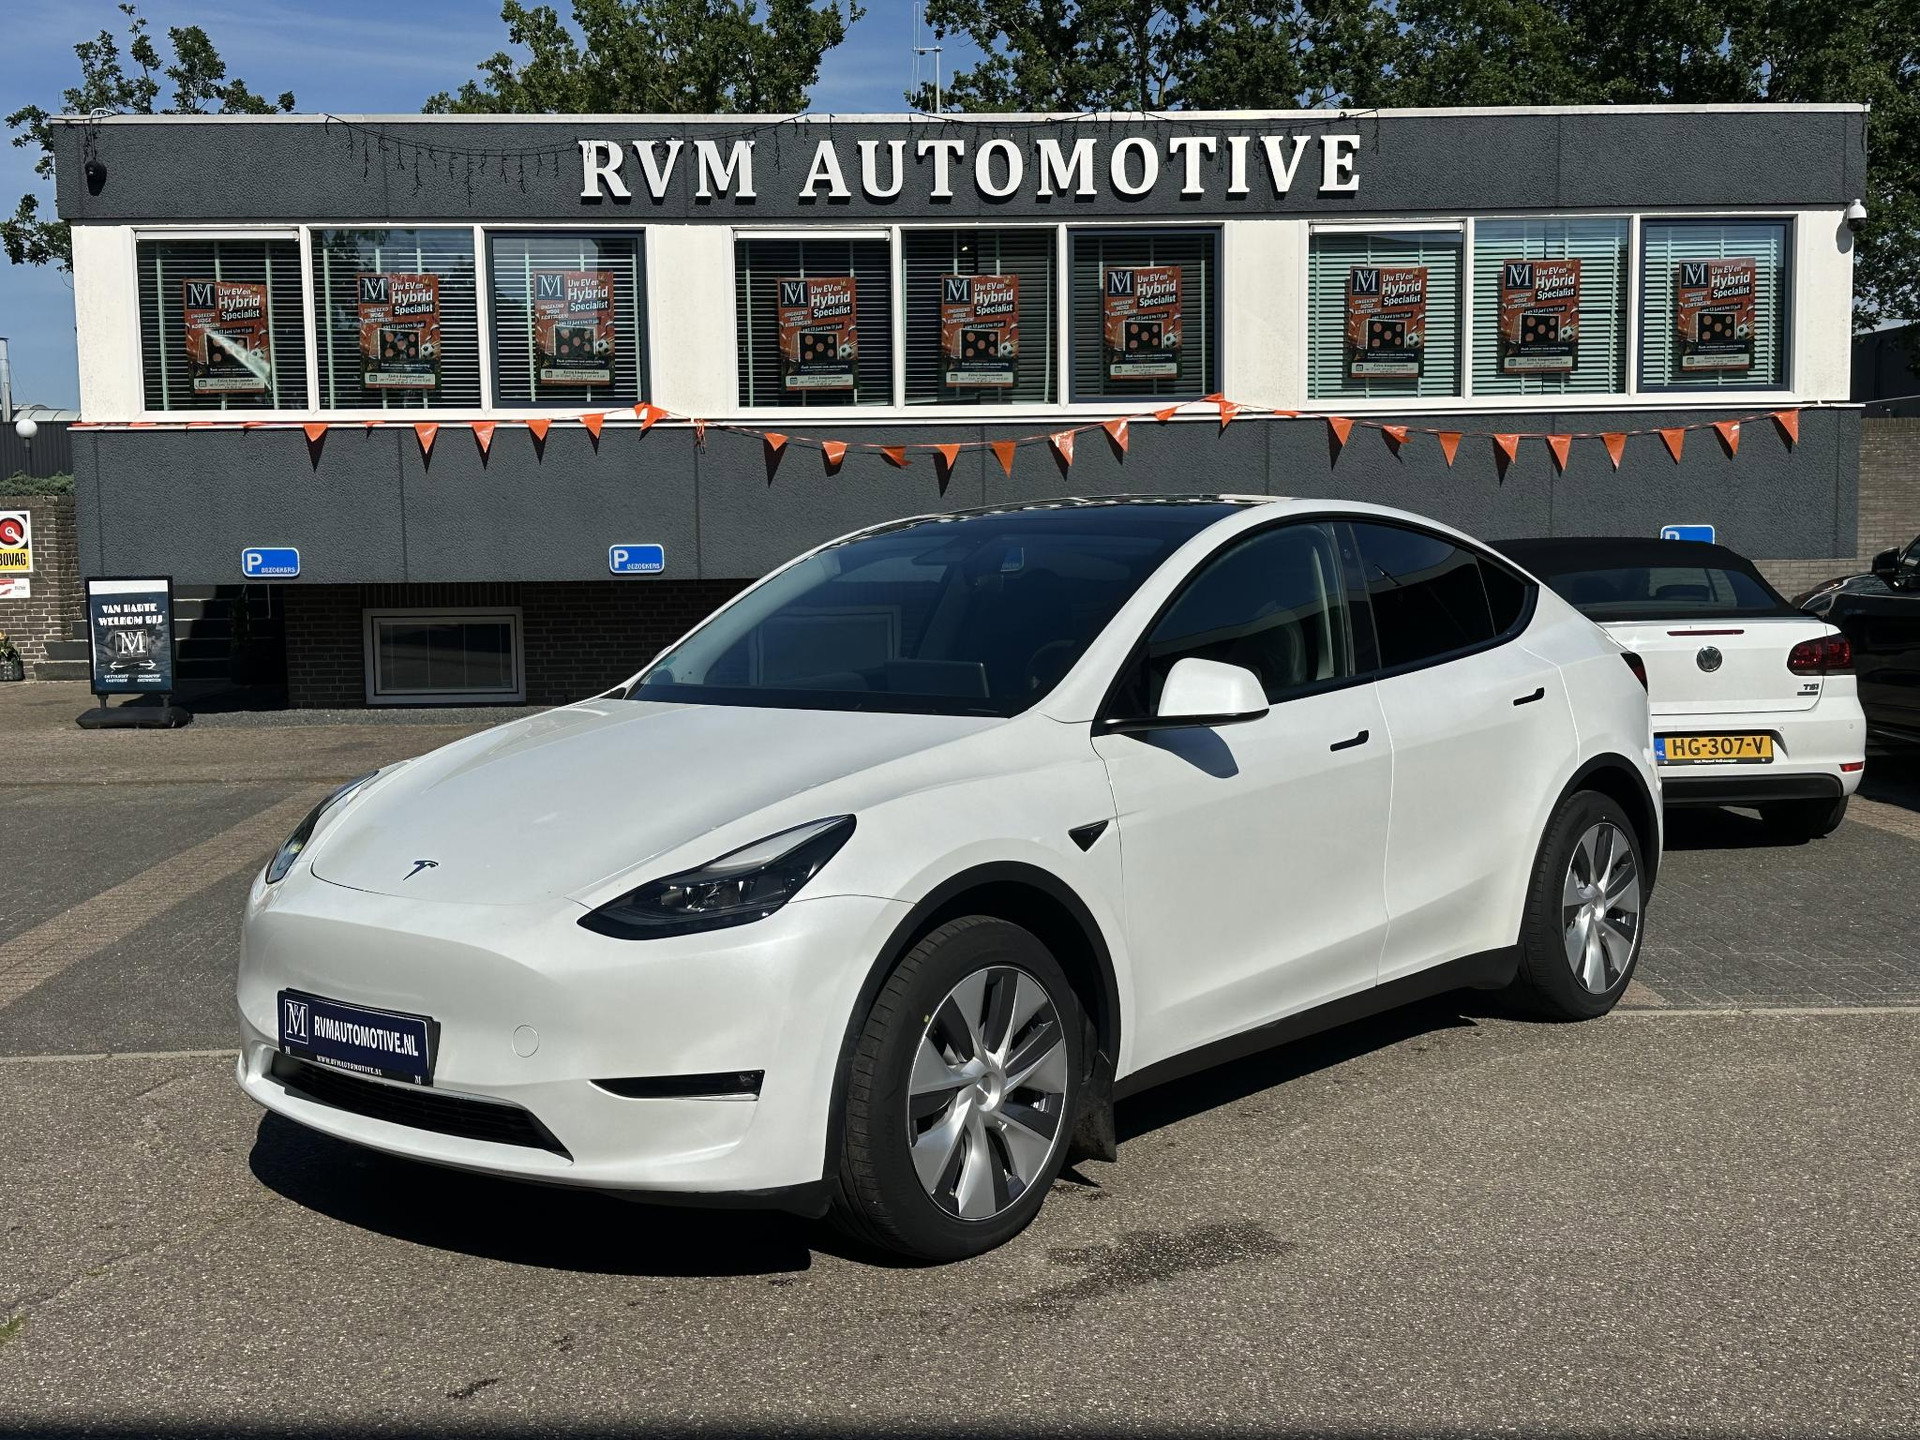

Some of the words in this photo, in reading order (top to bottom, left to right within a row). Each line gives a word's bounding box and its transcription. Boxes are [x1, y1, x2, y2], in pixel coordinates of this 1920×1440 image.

[578, 140, 757, 198] RVM
[799, 134, 1361, 198] AUTOMOTIVE
[1536, 268, 1548, 276] Uw
[1548, 266, 1559, 275] EV
[1711, 267, 1723, 275] Uw
[1723, 265, 1734, 274] EV
[568, 279, 580, 288] Uw
[580, 278, 591, 287] EV
[1137, 275, 1150, 283] Uw
[1150, 273, 1160, 282] EV
[1383, 274, 1395, 282] Uw
[1395, 273, 1406, 281] EV
[1535, 273, 1576, 291] Hybrid
[1711, 271, 1751, 289] Hybrid
[218, 288, 231, 296] Uw
[231, 287, 243, 295] EV
[392, 283, 404, 291] Uw
[405, 281, 416, 290] EV
[810, 286, 823, 294] Uw
[823, 284, 834, 292] EV
[974, 283, 987, 292] Uw
[987, 282, 997, 291] EV
[1137, 280, 1177, 298] Hybrid
[1382, 279, 1422, 297] Hybrid
[392, 289, 433, 306] Hybrid
[568, 286, 609, 302] Hybrid
[974, 289, 1014, 306] Hybrid
[1537, 288, 1575, 300] Specialist
[1713, 286, 1750, 299] Specialist
[219, 295, 260, 311] Hybrid
[810, 291, 851, 308] Hybrid
[1139, 295, 1177, 307] Specialist
[1383, 294, 1421, 306] Specialist
[394, 303, 433, 316] Specialist
[570, 300, 608, 312] Specialist
[813, 306, 851, 318] Specialist
[976, 304, 1014, 316] Specialist
[221, 309, 260, 321] Specialist
[247, 553, 262, 572] P
[613, 549, 629, 569] P
[102, 604, 121, 613] VAN
[1672, 736, 1764, 756] HG-307-V
[314, 1015, 419, 1057] RVMAUTOMOTIVE.NL
